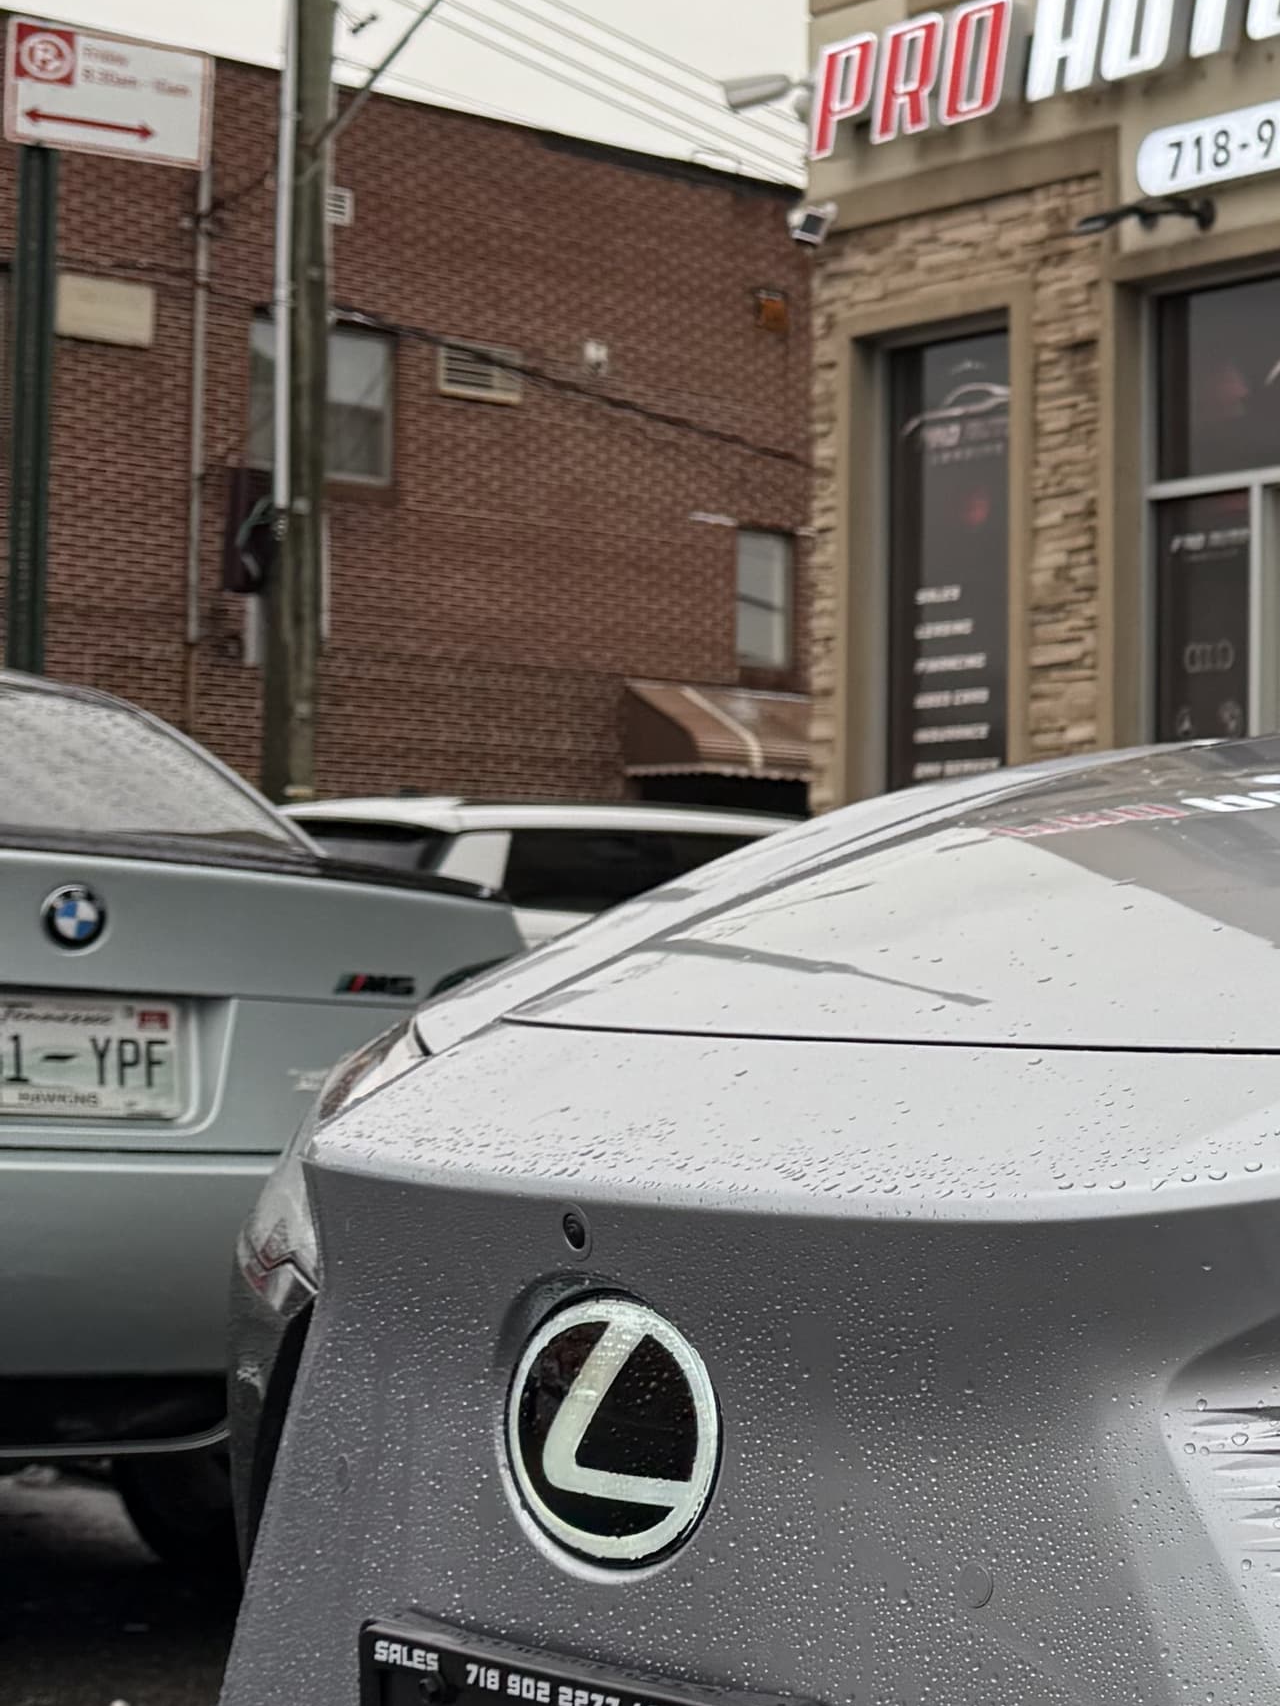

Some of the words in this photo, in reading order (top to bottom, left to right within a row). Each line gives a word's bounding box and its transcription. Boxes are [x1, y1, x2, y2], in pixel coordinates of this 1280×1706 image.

[0, 1034, 169, 1089] 1-YPF
[373, 1639, 440, 1672] SALES
[465, 1663, 500, 1691] 718
[506, 1674, 551, 1704] 902
